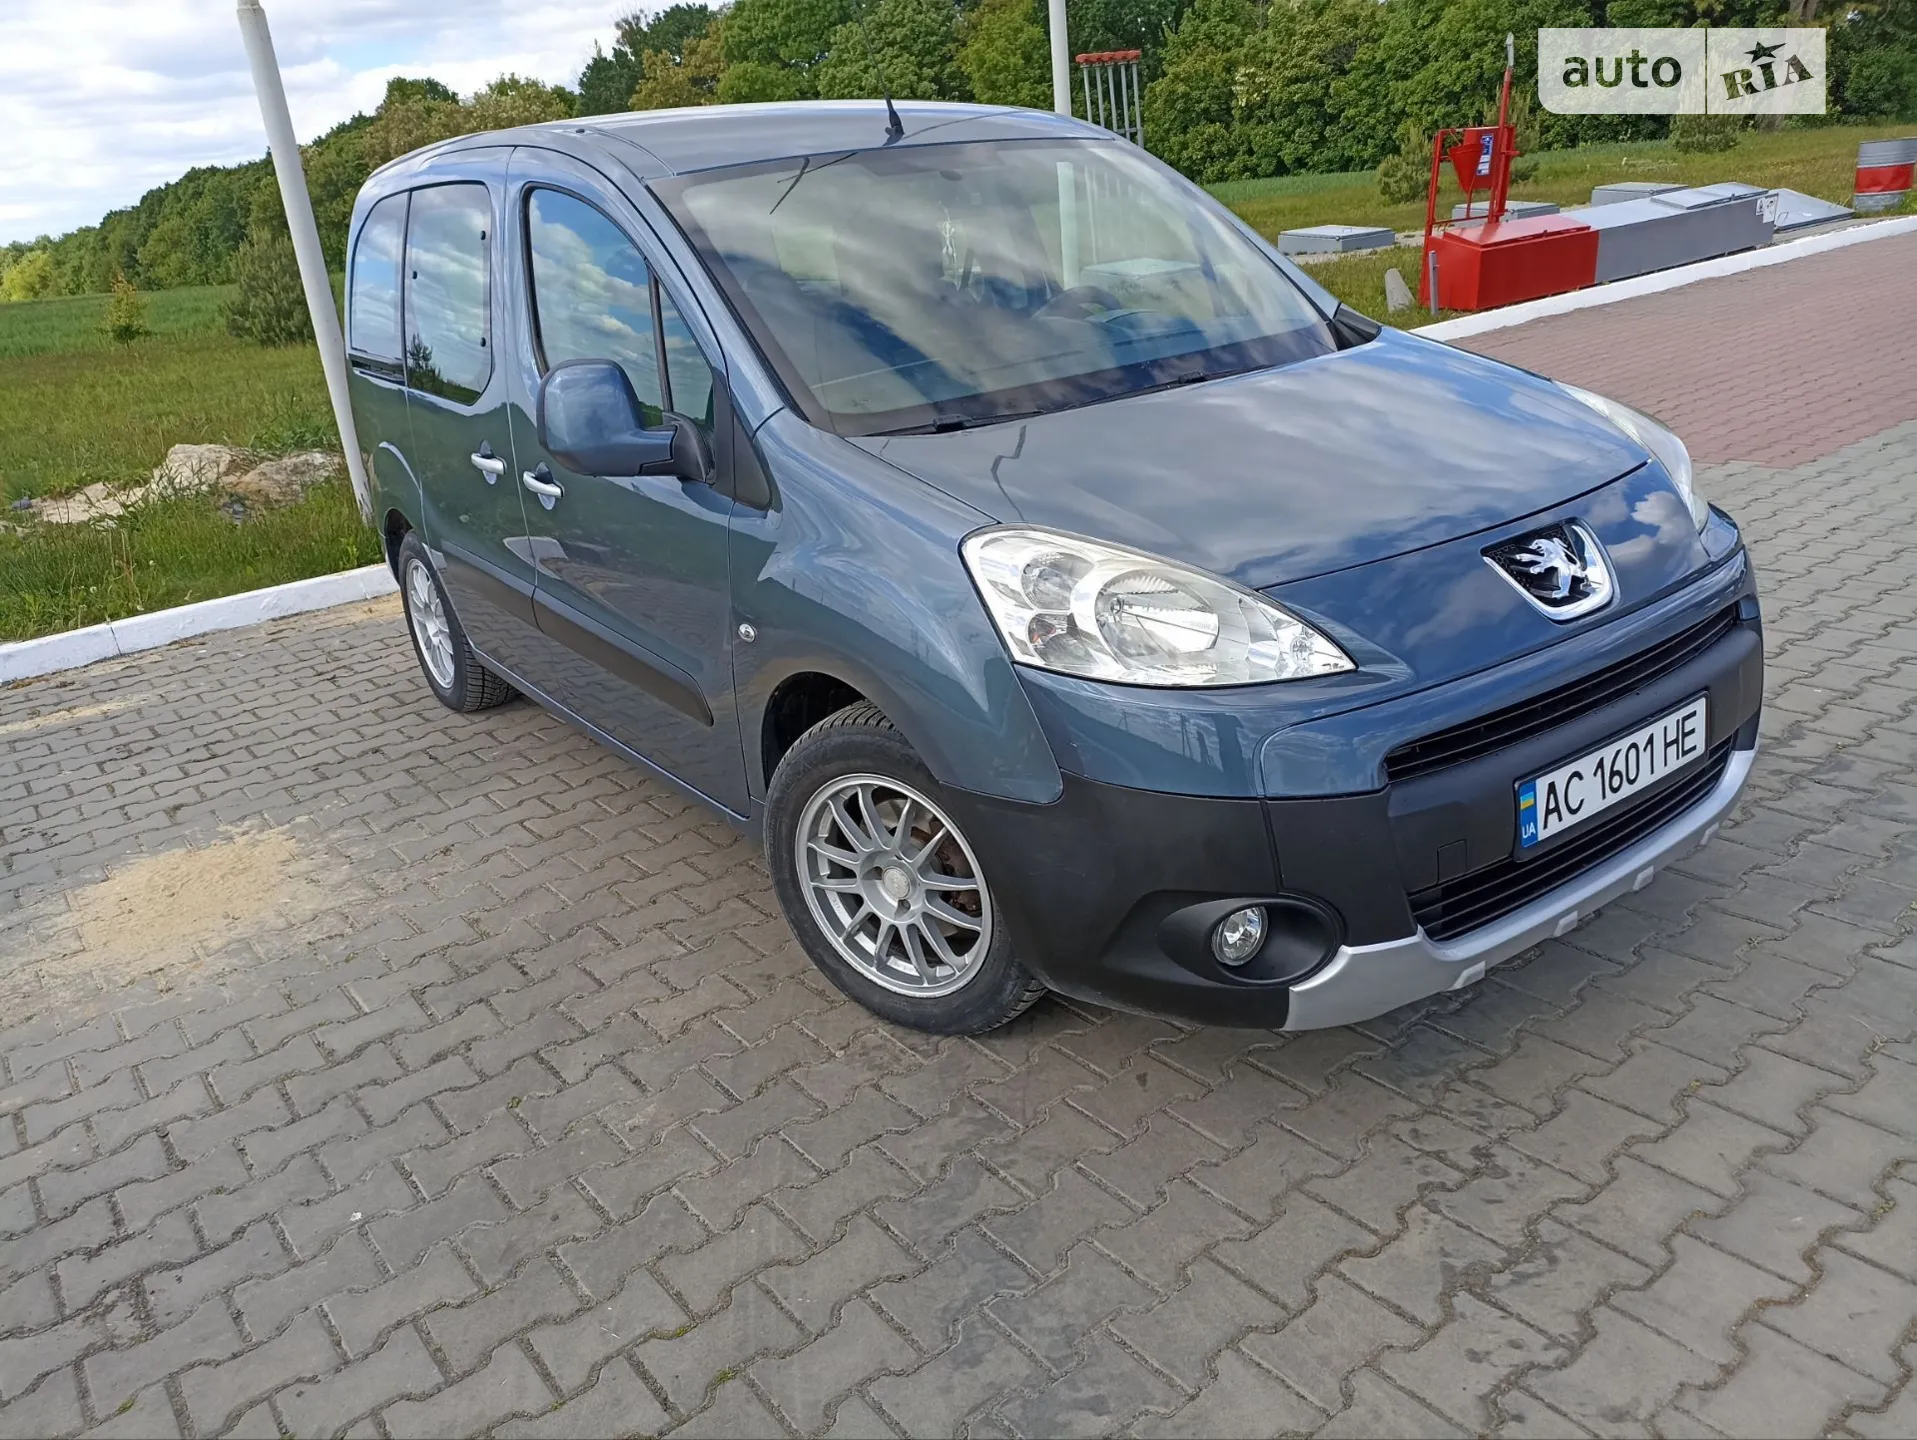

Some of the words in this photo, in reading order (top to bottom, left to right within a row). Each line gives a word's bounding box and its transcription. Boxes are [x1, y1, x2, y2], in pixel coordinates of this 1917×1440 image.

[1543, 770, 1584, 830] AC
[1593, 732, 1654, 800] 1601
[1663, 710, 1697, 767] HE
[1522, 822, 1536, 838] UA
